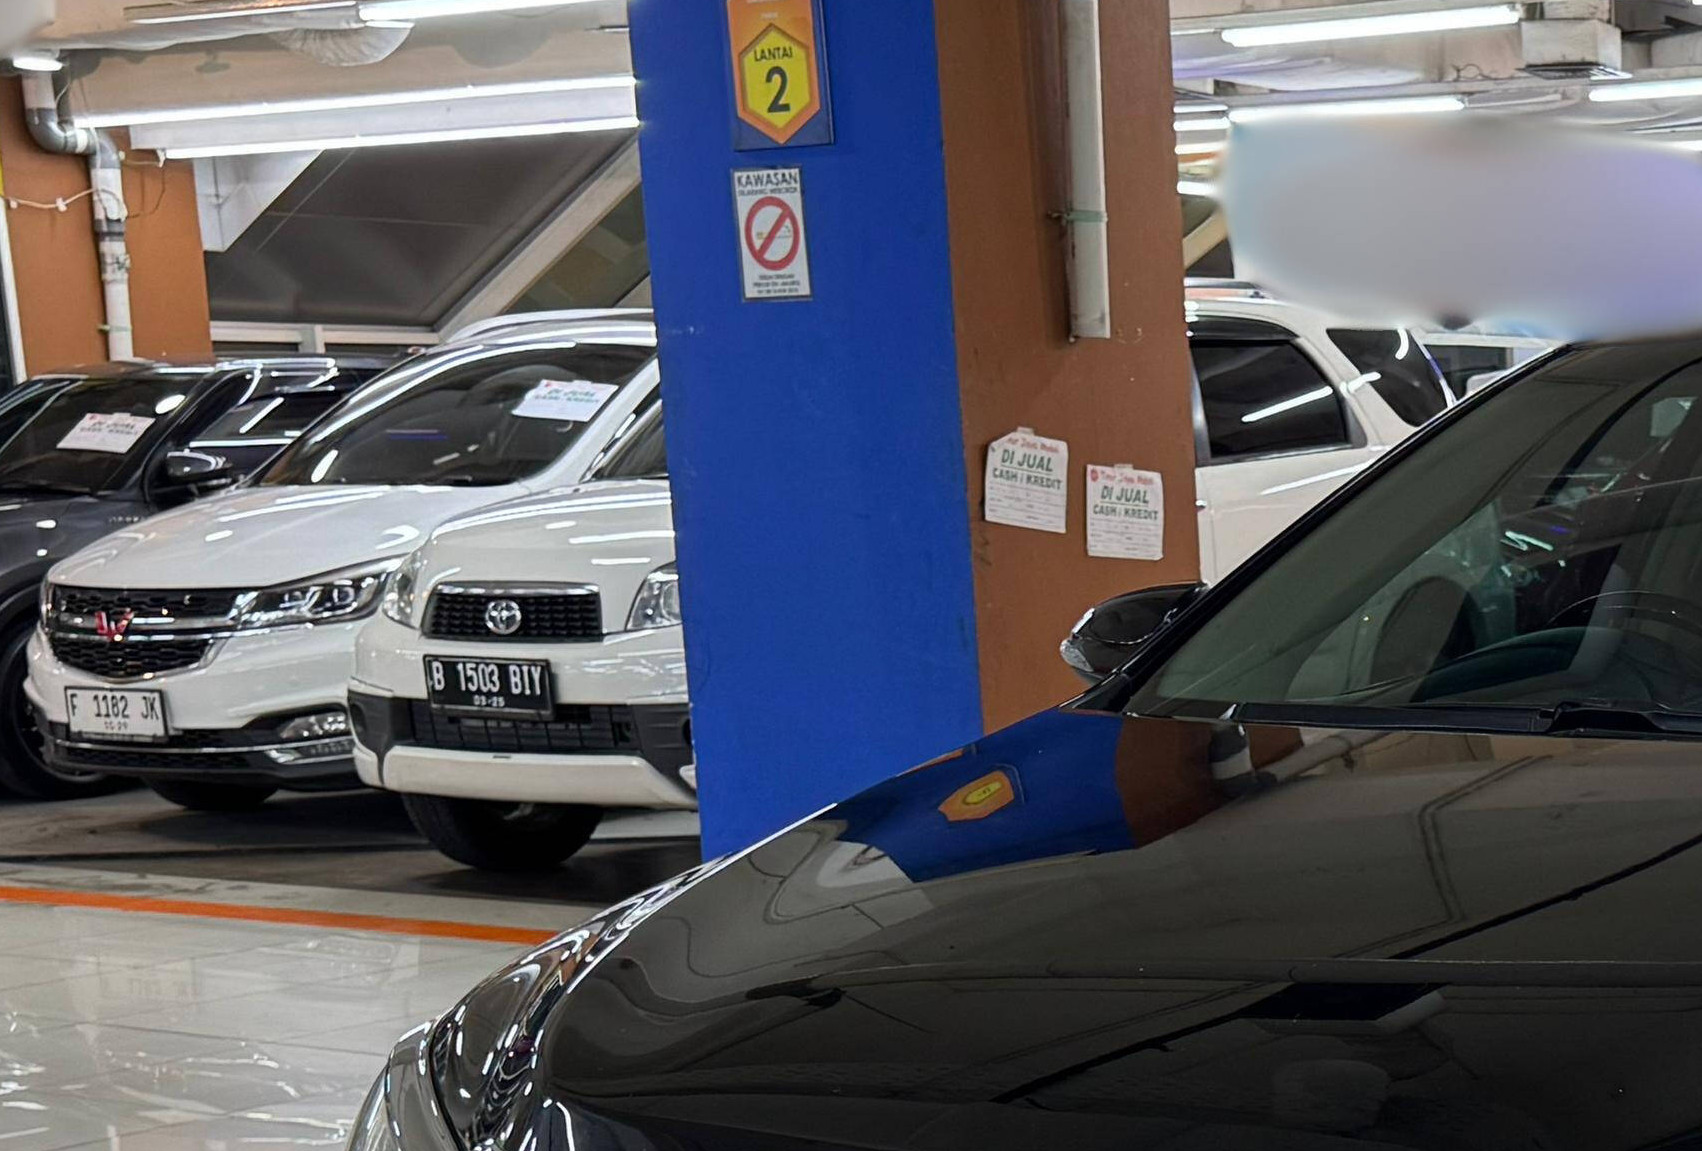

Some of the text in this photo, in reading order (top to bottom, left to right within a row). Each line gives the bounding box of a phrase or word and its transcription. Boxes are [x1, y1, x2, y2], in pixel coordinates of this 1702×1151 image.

[754, 47, 793, 61] LANTAI
[765, 66, 791, 113] 2
[737, 172, 798, 188] KAWASAN
[1001, 448, 1053, 472] DI JUAL
[993, 467, 1017, 481] CASH
[1026, 475, 1062, 490] KREDIT
[1101, 485, 1149, 504] DI JUAL
[1093, 504, 1117, 517] CASH
[1124, 508, 1158, 520] KREDIT
[431, 661, 541, 695] B 1503 BIY
[70, 693, 78, 716] F
[141, 696, 159, 720] JK
